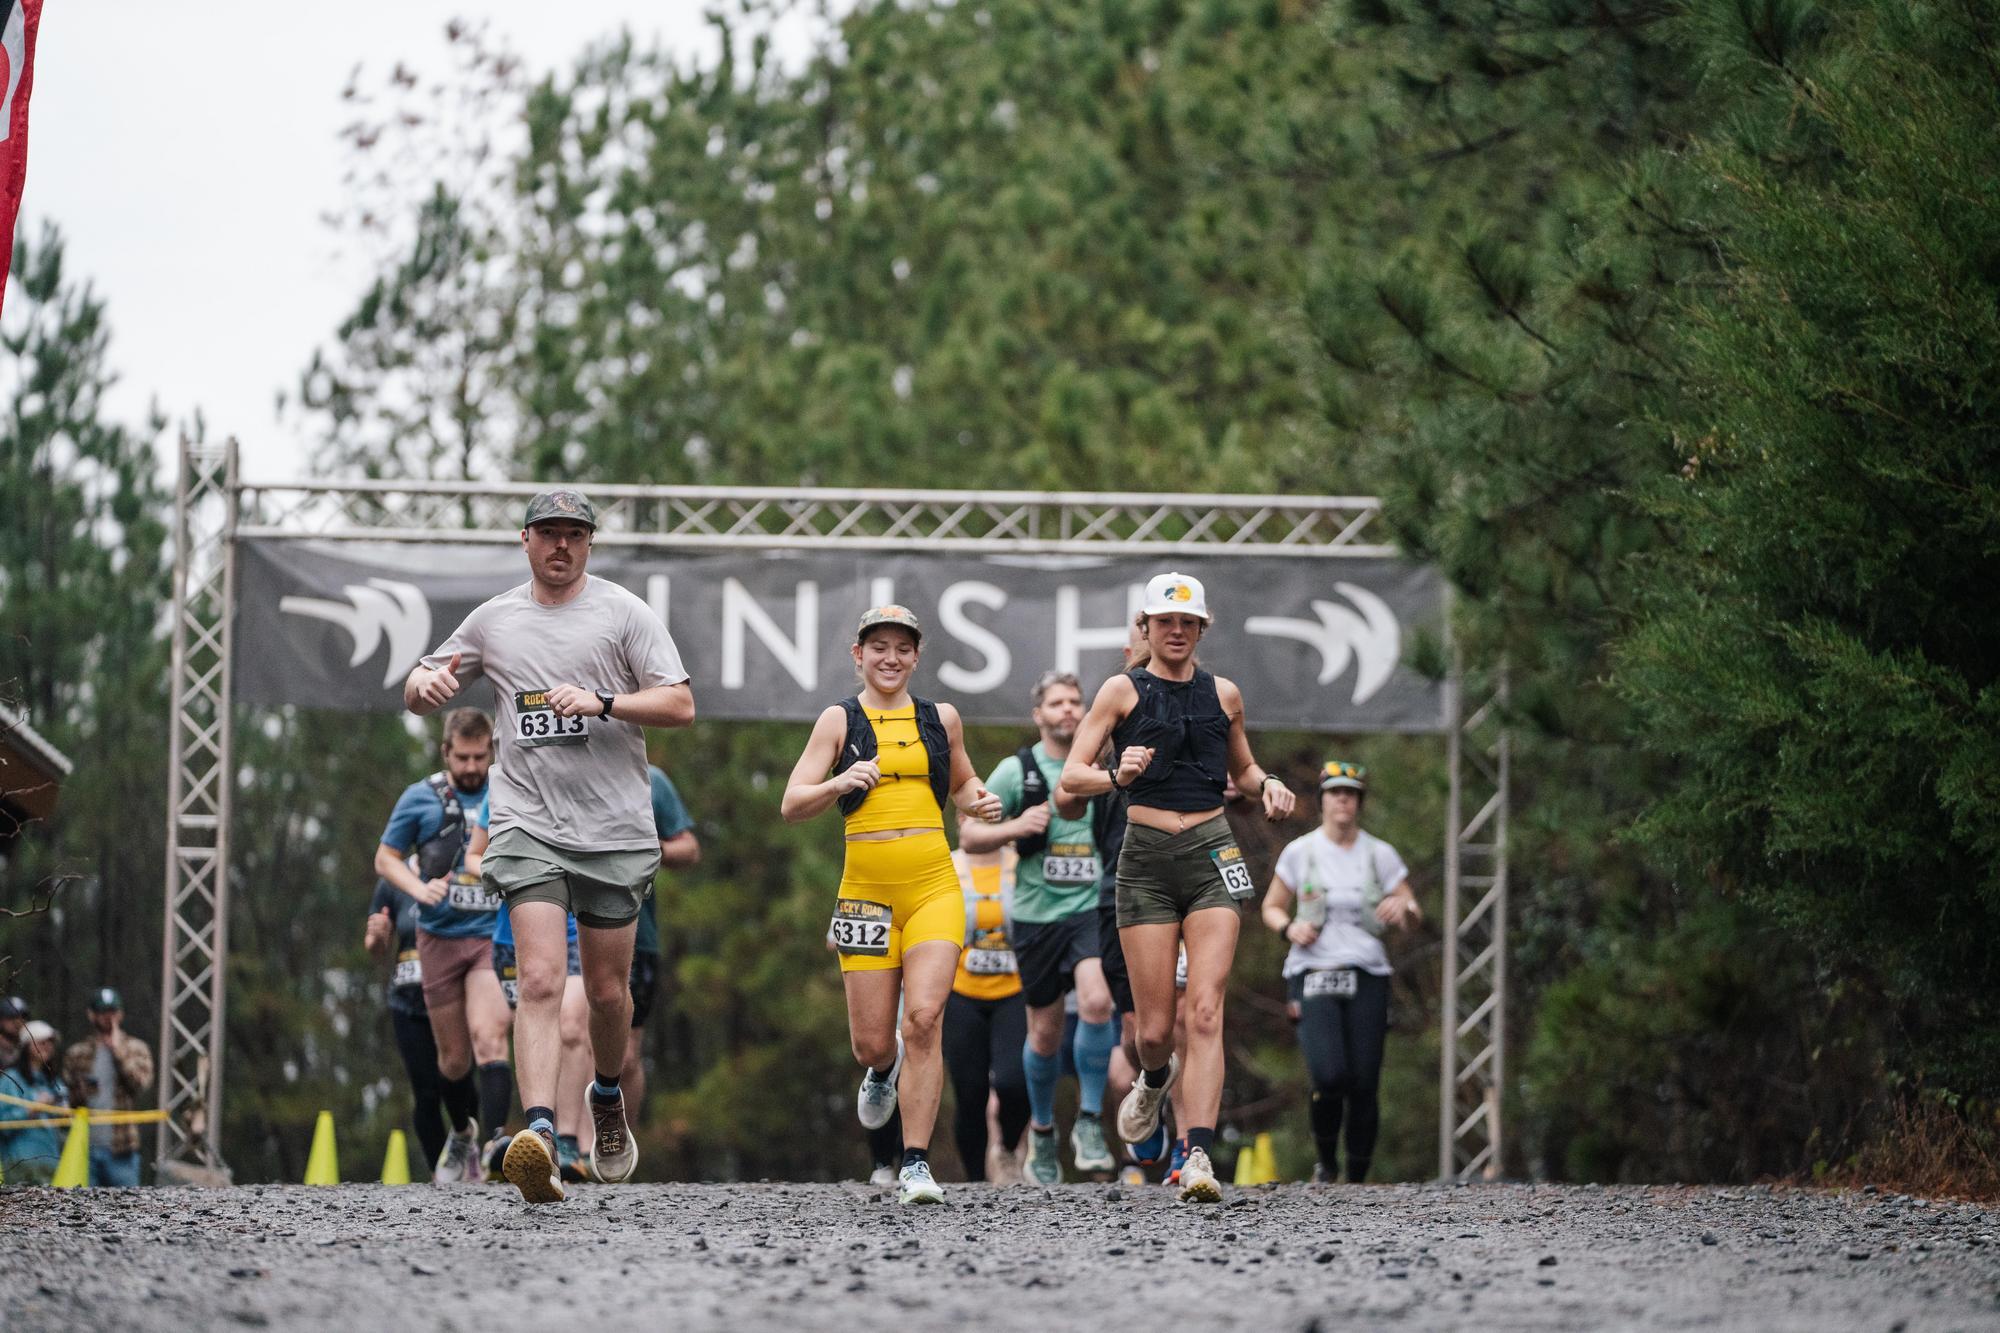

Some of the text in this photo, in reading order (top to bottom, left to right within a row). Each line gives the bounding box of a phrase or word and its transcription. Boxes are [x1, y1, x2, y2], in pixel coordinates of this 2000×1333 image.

[524, 693, 548, 706] ROCK
[521, 713, 584, 737] 6313
[1046, 860, 1094, 876] 6324
[1226, 866, 1249, 889] 63
[833, 921, 886, 946] 6312
